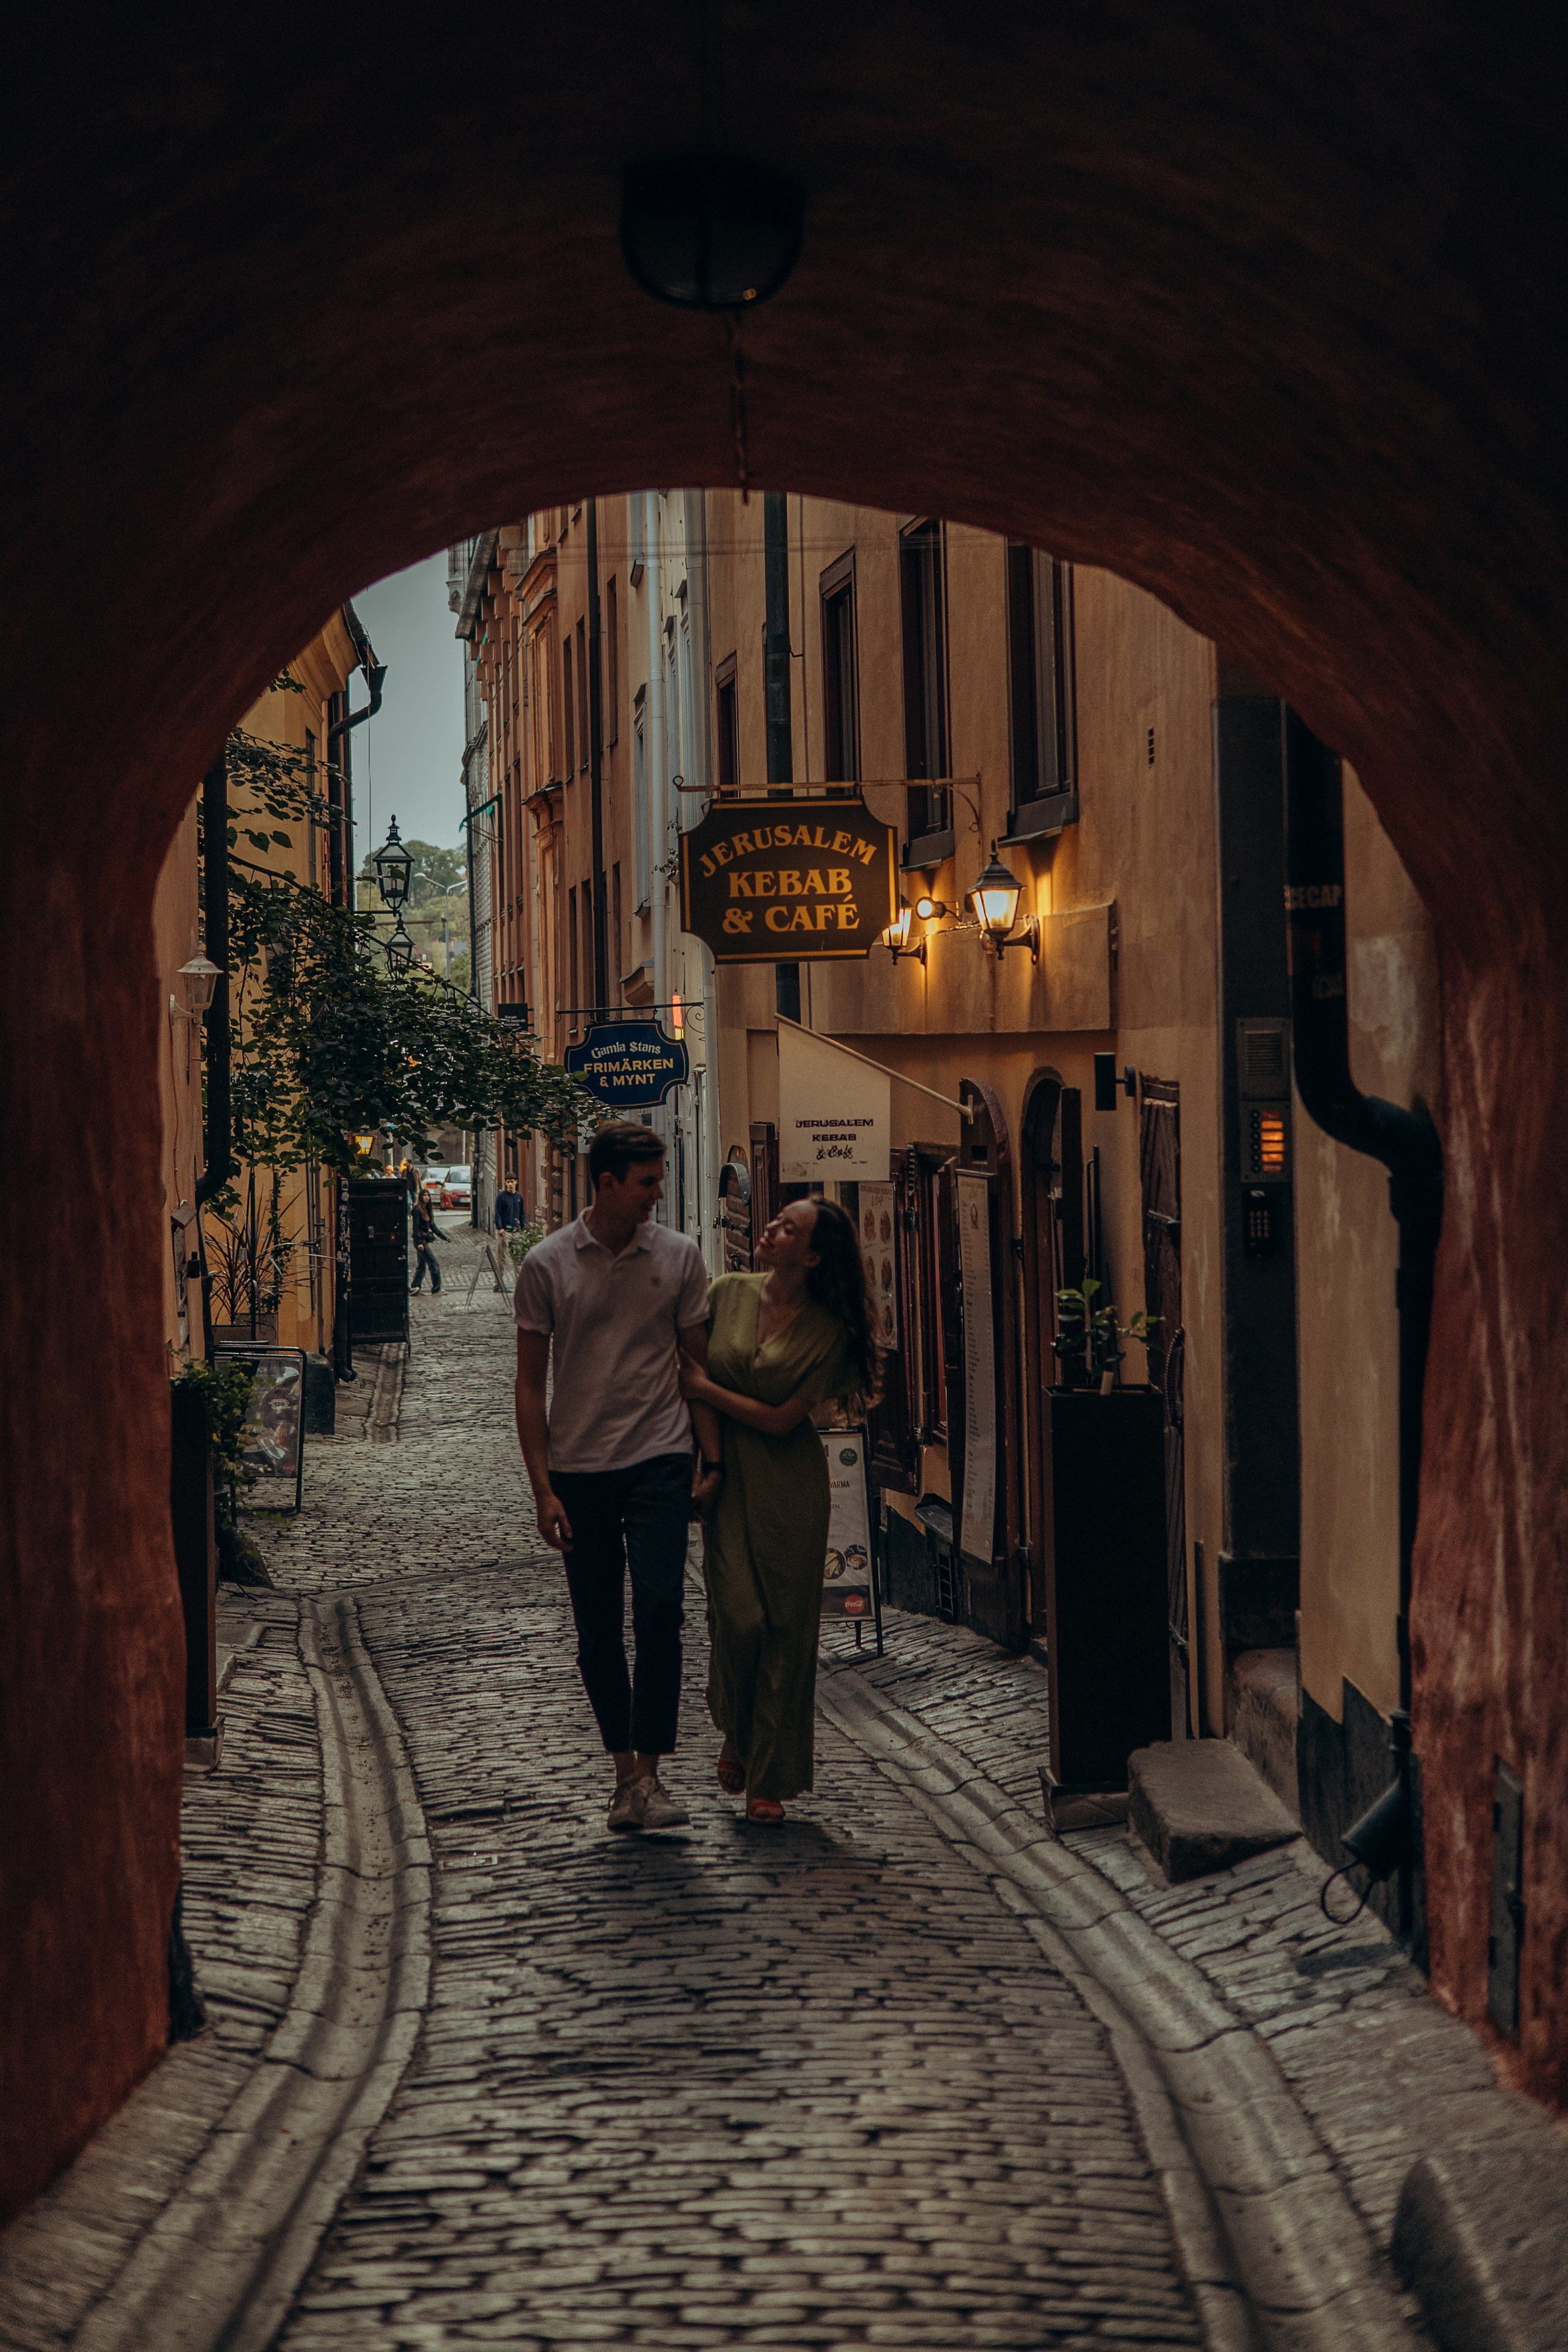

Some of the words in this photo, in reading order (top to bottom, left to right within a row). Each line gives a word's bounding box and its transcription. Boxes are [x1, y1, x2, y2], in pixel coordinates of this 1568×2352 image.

[699, 824, 877, 878] JERUSALEM
[728, 868, 853, 898] KEBAB
[722, 907, 753, 933] &
[765, 894, 860, 932] CAFÉ
[591, 1041, 626, 1059] Gamla
[629, 1041, 662, 1055] Stans
[583, 1058, 674, 1073] FRIMÄRKEN
[599, 1076, 609, 1088] &
[612, 1073, 655, 1086] MYNT
[796, 1118, 874, 1128] JERUSALEM
